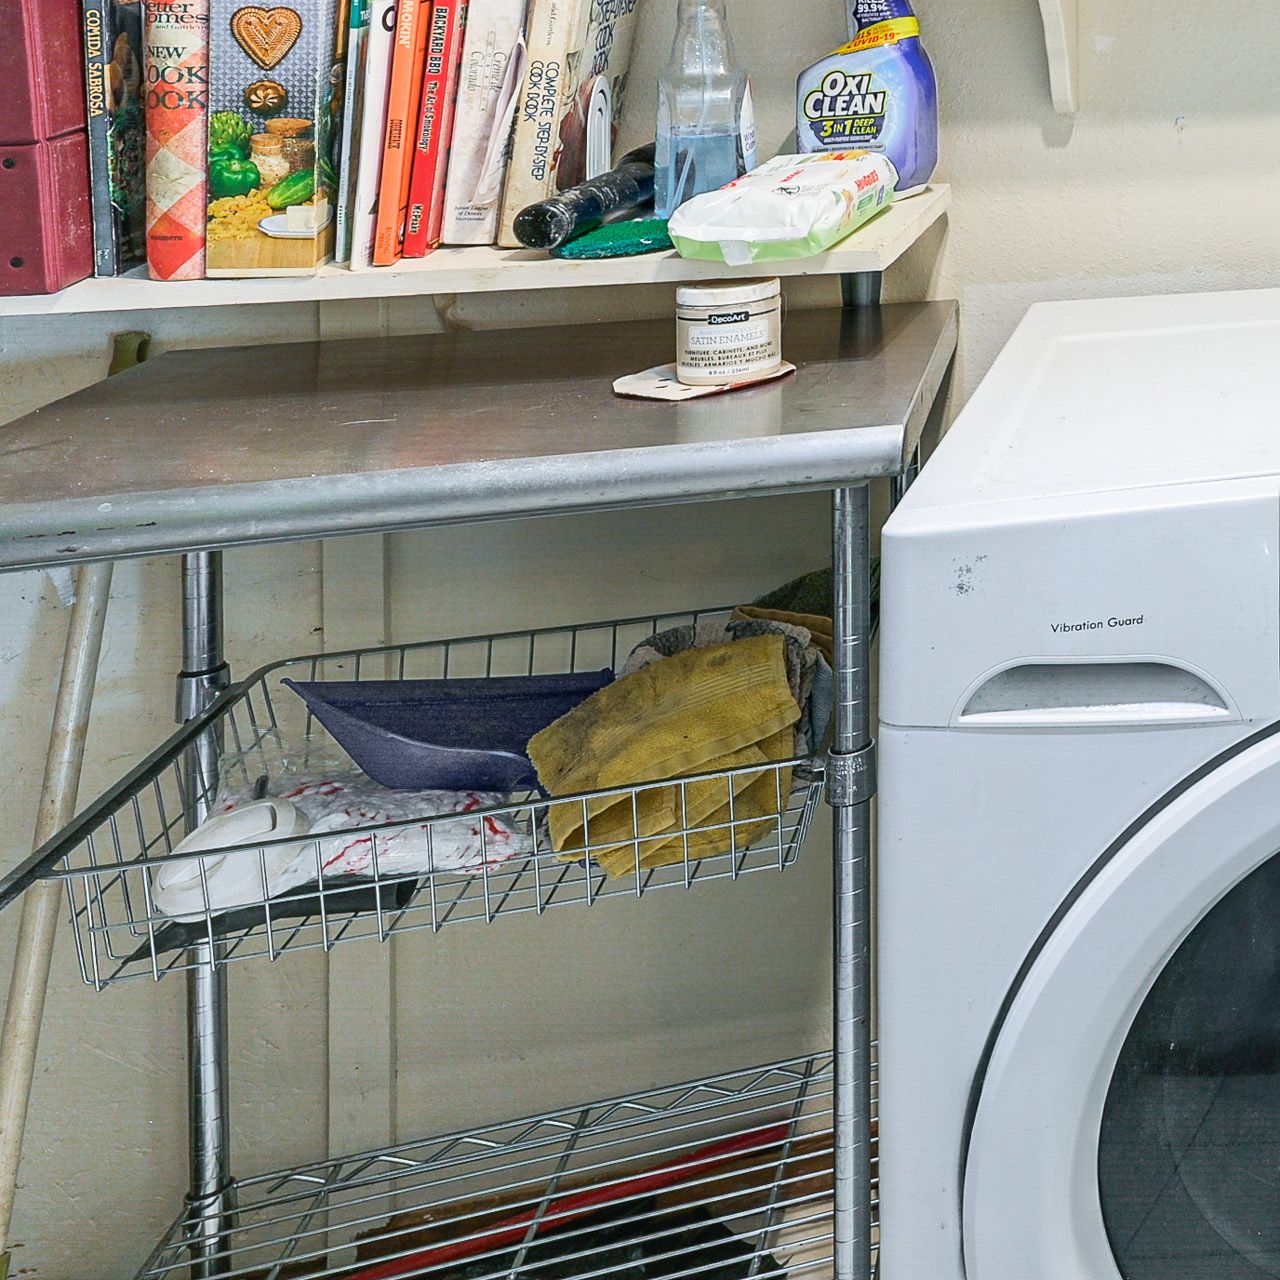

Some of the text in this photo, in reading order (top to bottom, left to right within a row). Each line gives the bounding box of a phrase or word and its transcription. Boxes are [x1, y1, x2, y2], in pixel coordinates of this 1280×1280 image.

[857, 3, 888, 13] 99.9%
[427, 7, 449, 75] BACKYARD BBQ
[595, 21, 616, 52] COOK
[85, 8, 104, 117] COMIDA SABROSA
[147, 45, 188, 60] NEW
[147, 64, 209, 85] OOK
[466, 51, 484, 92] Colorado
[523, 60, 545, 122] COOK BOOK
[821, 71, 872, 97] OXI
[146, 89, 209, 111] OOK
[804, 90, 887, 119] CLEAN
[531, 61, 560, 182] COMPLETE STEP-BY-STEP
[820, 120, 853, 137] 3 IN 1
[852, 125, 878, 134] CLEAN
[853, 118, 875, 126] DEEP
[854, 169, 879, 190] HUGGIES
[409, 204, 423, 234] McPeake
[711, 314, 746, 324] DecoArt
[690, 331, 763, 346] SATIN ENAMELS
[1050, 614, 1144, 633] Vibration Guard
